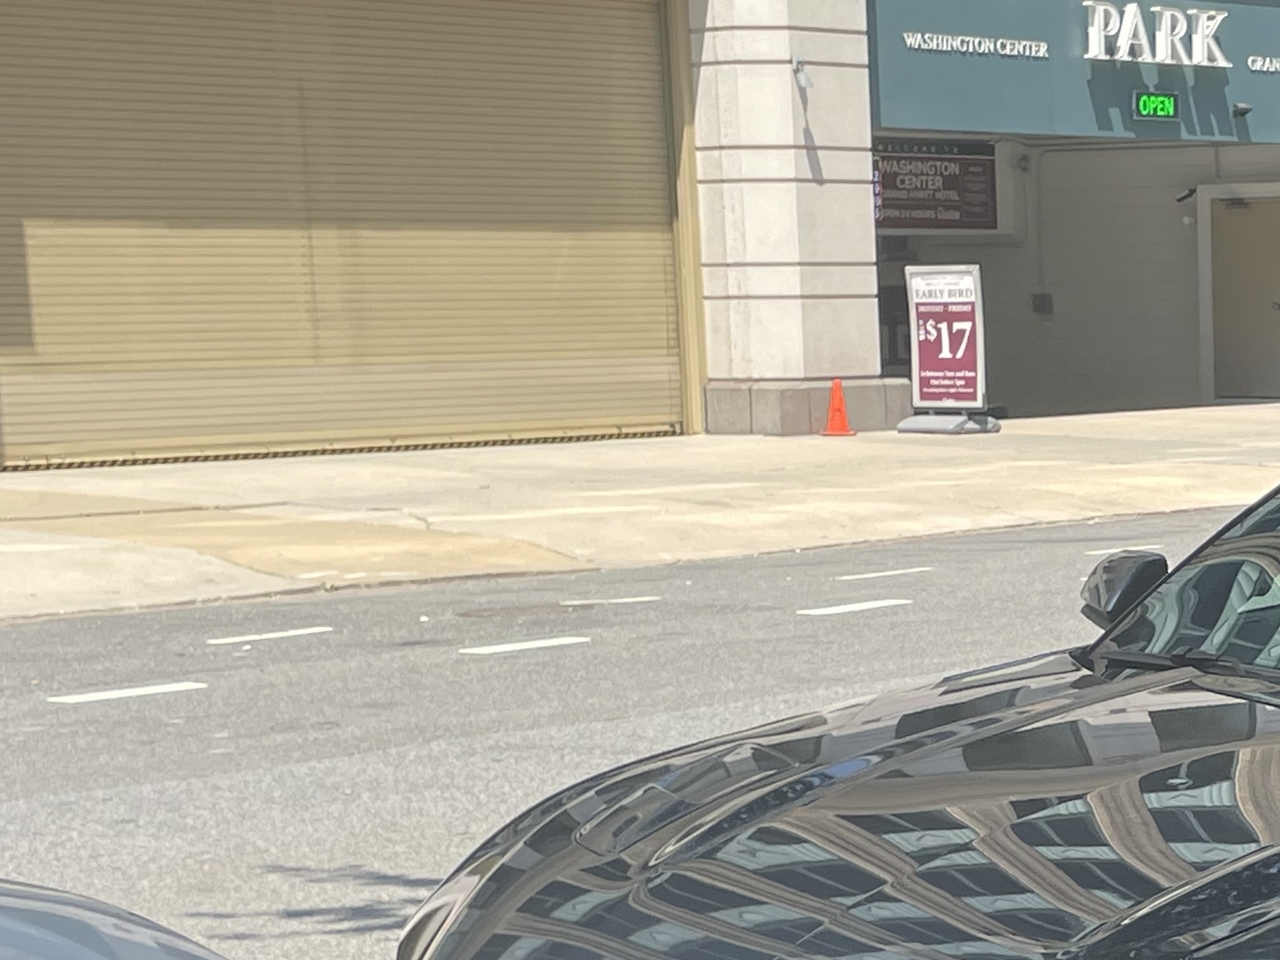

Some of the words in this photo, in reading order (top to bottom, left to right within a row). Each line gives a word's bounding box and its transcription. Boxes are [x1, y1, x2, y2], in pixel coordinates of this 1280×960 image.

[902, 32, 995, 54] WASHINGTON
[997, 38, 1049, 58] CENTER
[1082, 1, 1233, 68] PARK
[1139, 95, 1174, 116] OPEN
[880, 161, 960, 175] WASHINGTON
[896, 175, 943, 189] CENTER
[915, 289, 945, 299] EARLY
[947, 288, 973, 299] BIRD
[926, 319, 973, 359] $17
